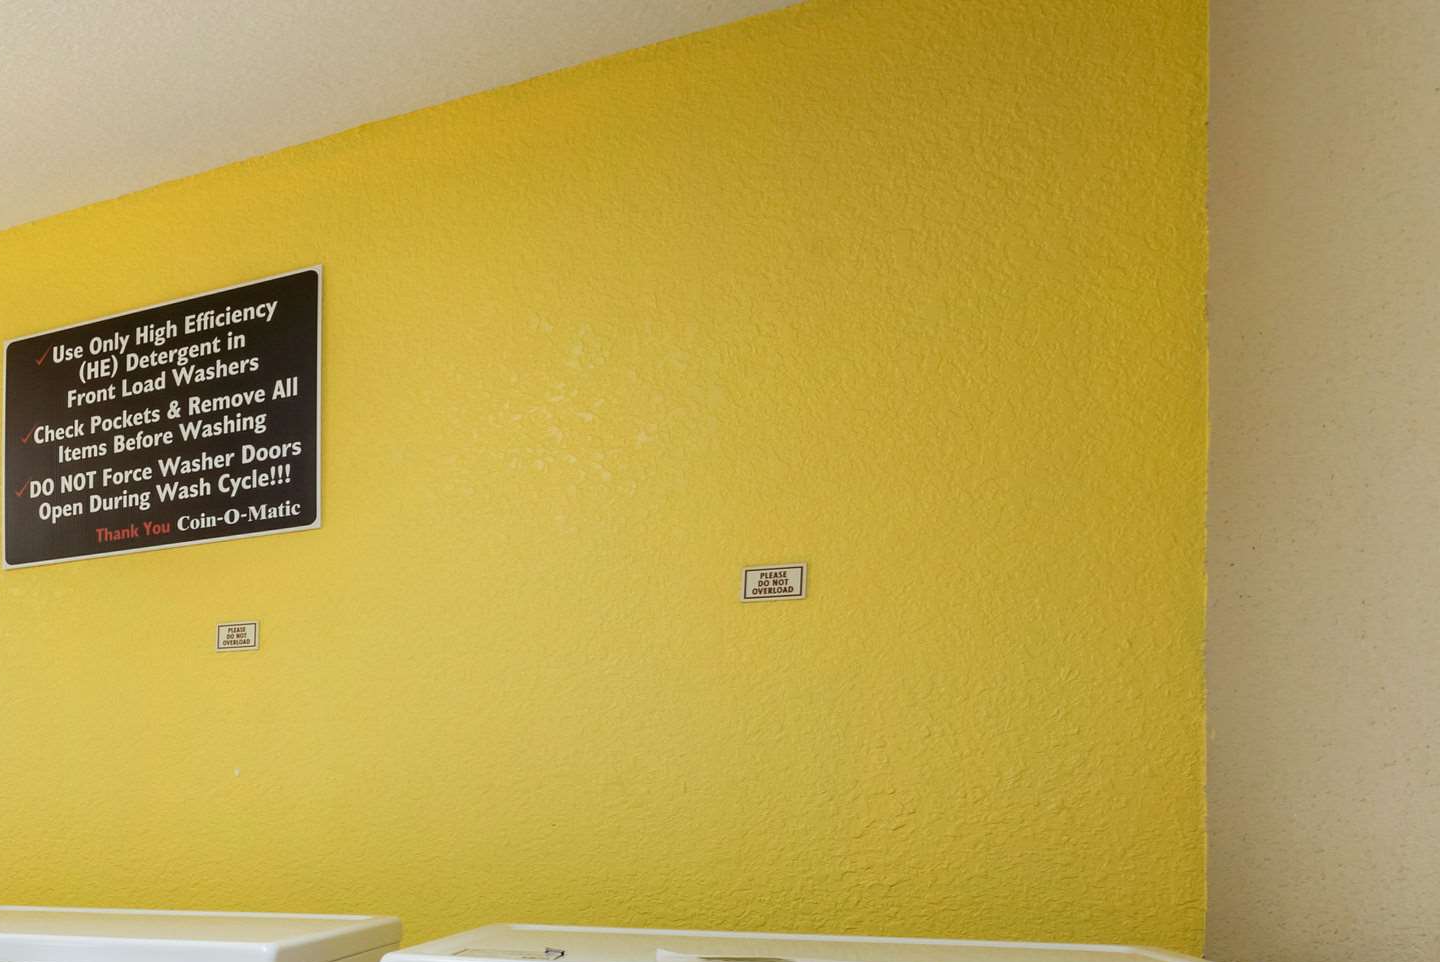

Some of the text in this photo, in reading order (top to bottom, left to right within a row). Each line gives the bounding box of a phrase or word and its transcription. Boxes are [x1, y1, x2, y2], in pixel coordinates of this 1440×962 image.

[52, 300, 278, 364] Use Only High Efficiency
[79, 331, 246, 384] (HE) Detergent in
[67, 356, 260, 408] Front Load Washers
[33, 377, 298, 445] Check Pockets & Remove All
[58, 413, 267, 464] Items Before Washing
[29, 441, 302, 499] DO NOT Force Washer Doors
[38, 463, 291, 524] Open During Wash Cycle!!!
[96, 500, 301, 544] Thank You Coin-O-Matic
[752, 586, 794, 595] OVERLOAD
[760, 571, 787, 579] PLEASE
